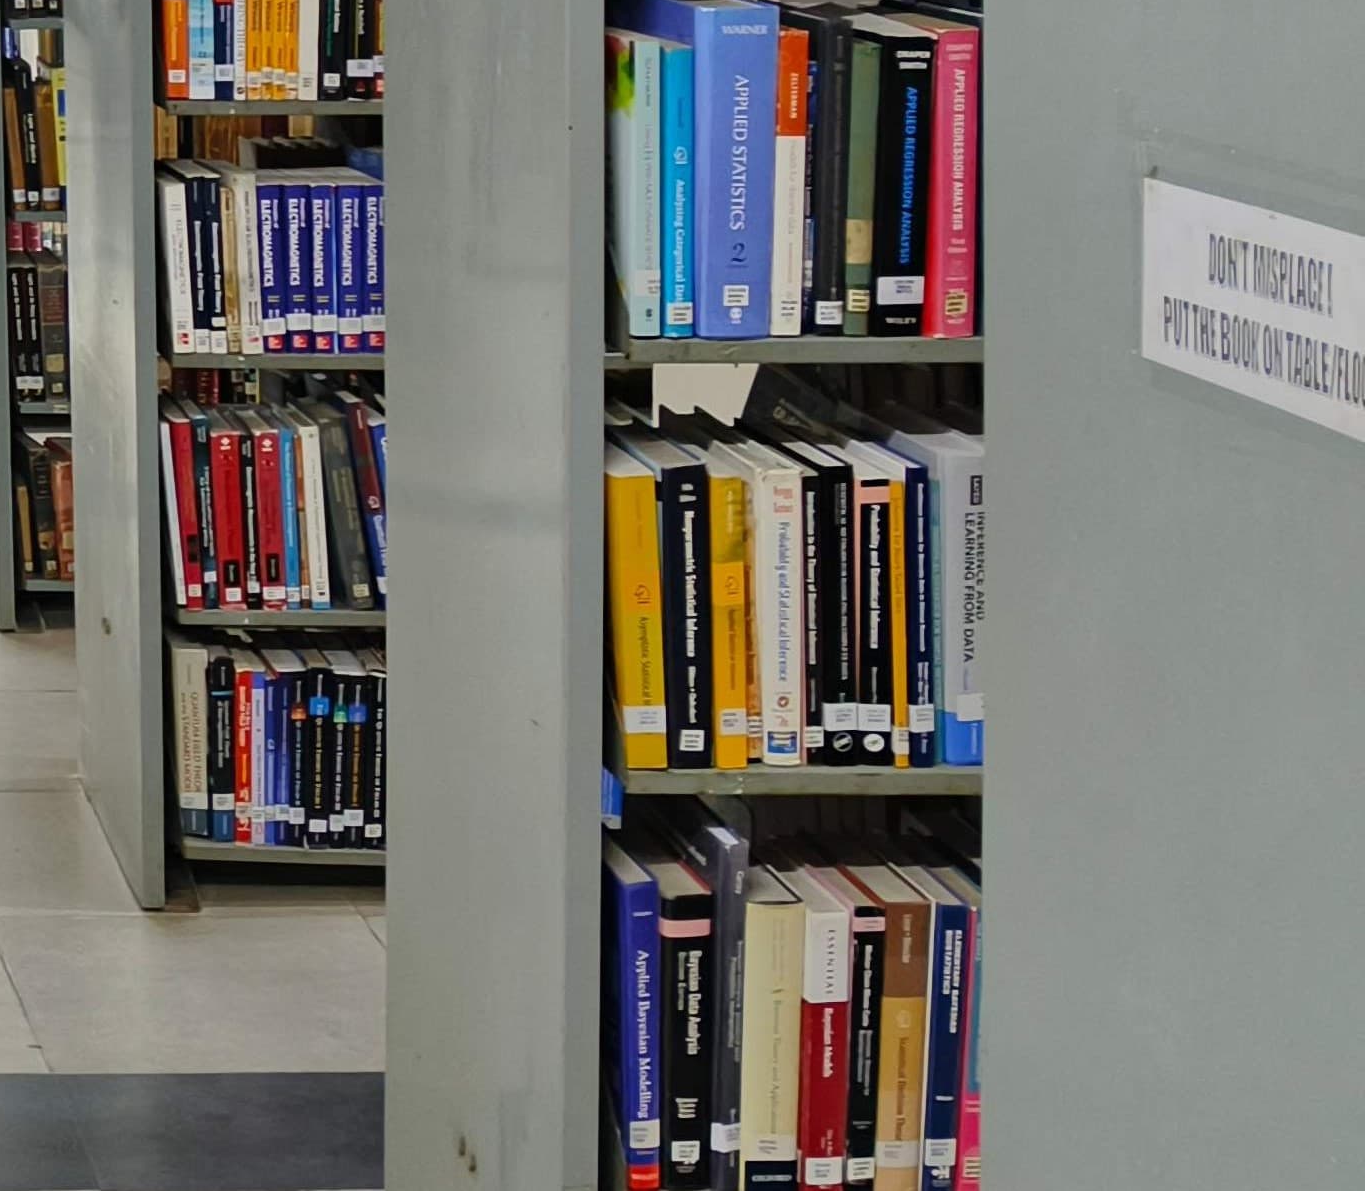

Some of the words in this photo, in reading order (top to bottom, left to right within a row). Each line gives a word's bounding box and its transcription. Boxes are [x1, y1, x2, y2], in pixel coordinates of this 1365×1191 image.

[733, 74, 749, 142] APPLIED
[789, 72, 799, 119] ZELTERMAN
[905, 86, 918, 135] APPLIED
[953, 68, 966, 112] APPLIED
[953, 114, 966, 178] REGRESSION
[729, 145, 749, 230] STATISTICS
[902, 137, 917, 209] REGRESSION
[952, 180, 966, 231] ANALYSIS
[261, 199, 274, 287] ELECTROMAGNETICS
[288, 198, 300, 286] ELECTROMAGNETICS
[313, 199, 324, 287] ELECTROMAGNETICS
[341, 198, 352, 286] ELECTROMAGNETICS
[366, 197, 377, 284] ELECTROMAGNETICS
[673, 229, 686, 283] Categorical
[730, 241, 747, 263] 2
[899, 211, 913, 264] ANALYSIS
[1208, 232, 1250, 294] DON'T
[1163, 295, 1189, 351] PUT
[1192, 303, 1217, 358] THE
[1219, 311, 1261, 375] BOOK
[1263, 323, 1283, 382] ON
[775, 521, 789, 570] Probability
[963, 512, 975, 580] LEARNING
[975, 511, 986, 586] INFERENCE
[778, 573, 790, 588] and
[964, 586, 975, 625] FROM
[976, 591, 986, 620] AND
[778, 590, 790, 639] Statistical
[778, 640, 790, 682] Inference
[963, 628, 974, 662] DATA
[640, 660, 652, 699] Statistical
[636, 950, 650, 998] Applied
[687, 950, 702, 992] Bayesian
[824, 929, 836, 995] ESSENTIAL
[943, 930, 953, 996] BIOSTATISTICS
[952, 929, 963, 988] ELEMENTARY
[637, 1001, 651, 1055] Bayesian
[688, 993, 702, 1015] Data
[949, 990, 960, 1034] BAYESIAN
[686, 1016, 701, 1055] Analysis
[636, 1057, 651, 1119] Modelling
